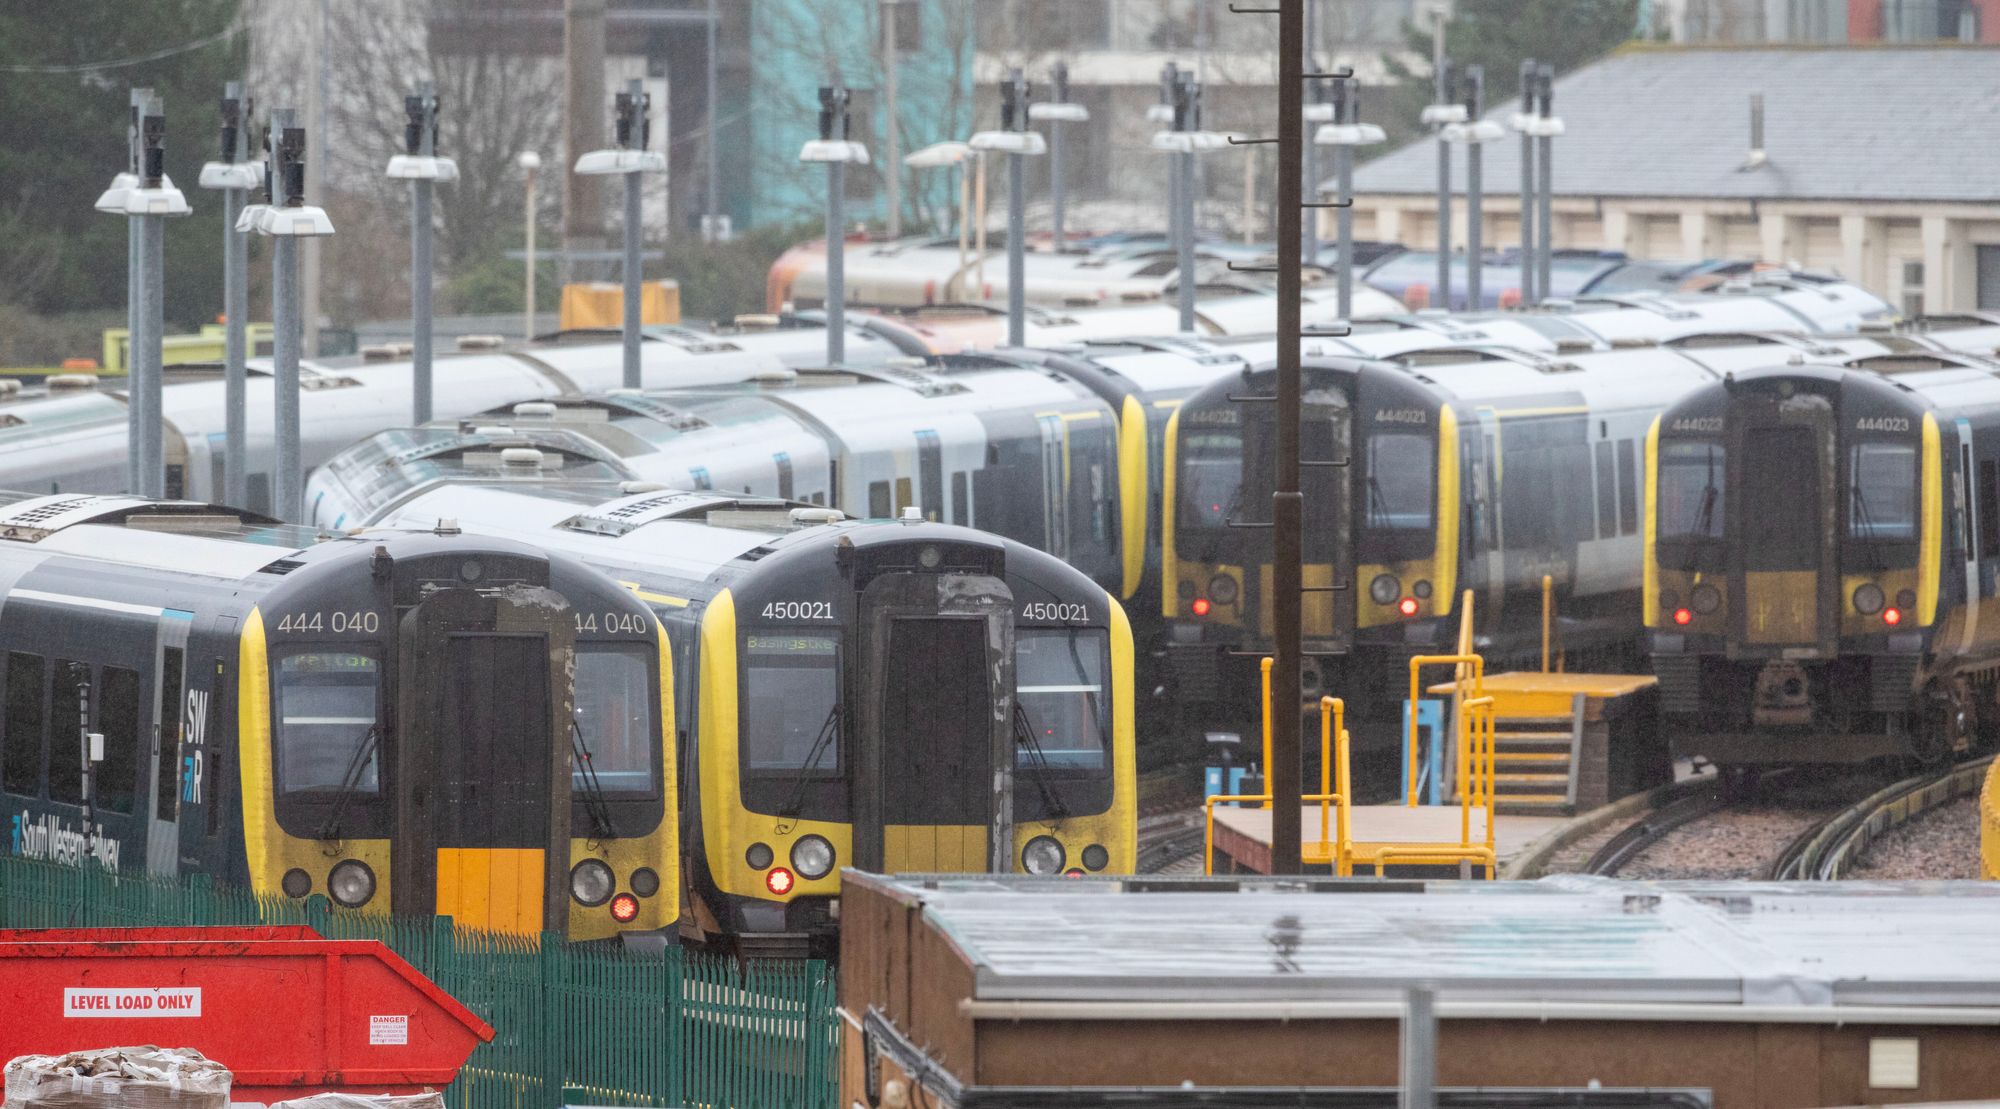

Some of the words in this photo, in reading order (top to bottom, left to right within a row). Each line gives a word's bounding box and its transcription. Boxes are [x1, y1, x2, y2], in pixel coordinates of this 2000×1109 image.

[1856, 417, 1909, 431] 444023
[762, 602, 834, 619] 450021
[1022, 603, 1090, 622] 450021
[277, 612, 324, 633] 444
[332, 611, 379, 633] 040
[605, 612, 646, 634] 040
[186, 688, 208, 745] SW
[89, 823, 120, 887] ailway
[71, 995, 111, 1010] LEVEL
[115, 995, 153, 1010] LOAD
[157, 994, 194, 1010] ONLY
[373, 1016, 406, 1024] DANGER
